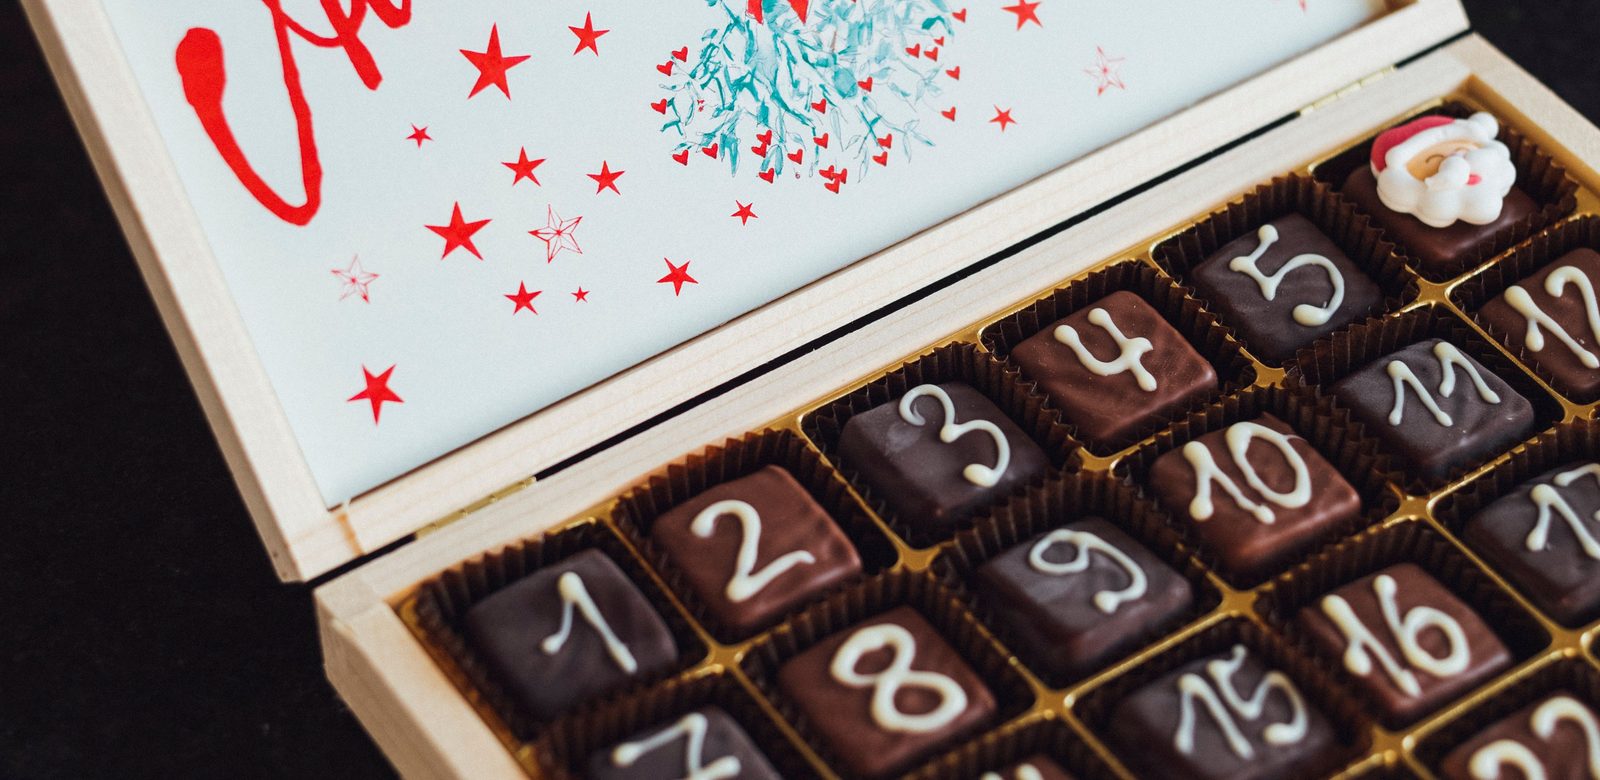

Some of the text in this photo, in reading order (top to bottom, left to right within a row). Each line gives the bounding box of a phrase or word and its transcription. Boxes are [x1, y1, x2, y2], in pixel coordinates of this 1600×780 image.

[1230, 224, 1345, 326] 5
[1053, 308, 1157, 391] 4
[1387, 342, 1501, 426] 11
[900, 384, 1010, 487] 3
[1183, 422, 1312, 525] 10
[691, 500, 816, 602] 2
[1029, 529, 1147, 613] 9
[541, 571, 638, 673] 1
[1321, 575, 1470, 697] 16
[830, 624, 968, 732] 8
[1175, 645, 1308, 759] 15
